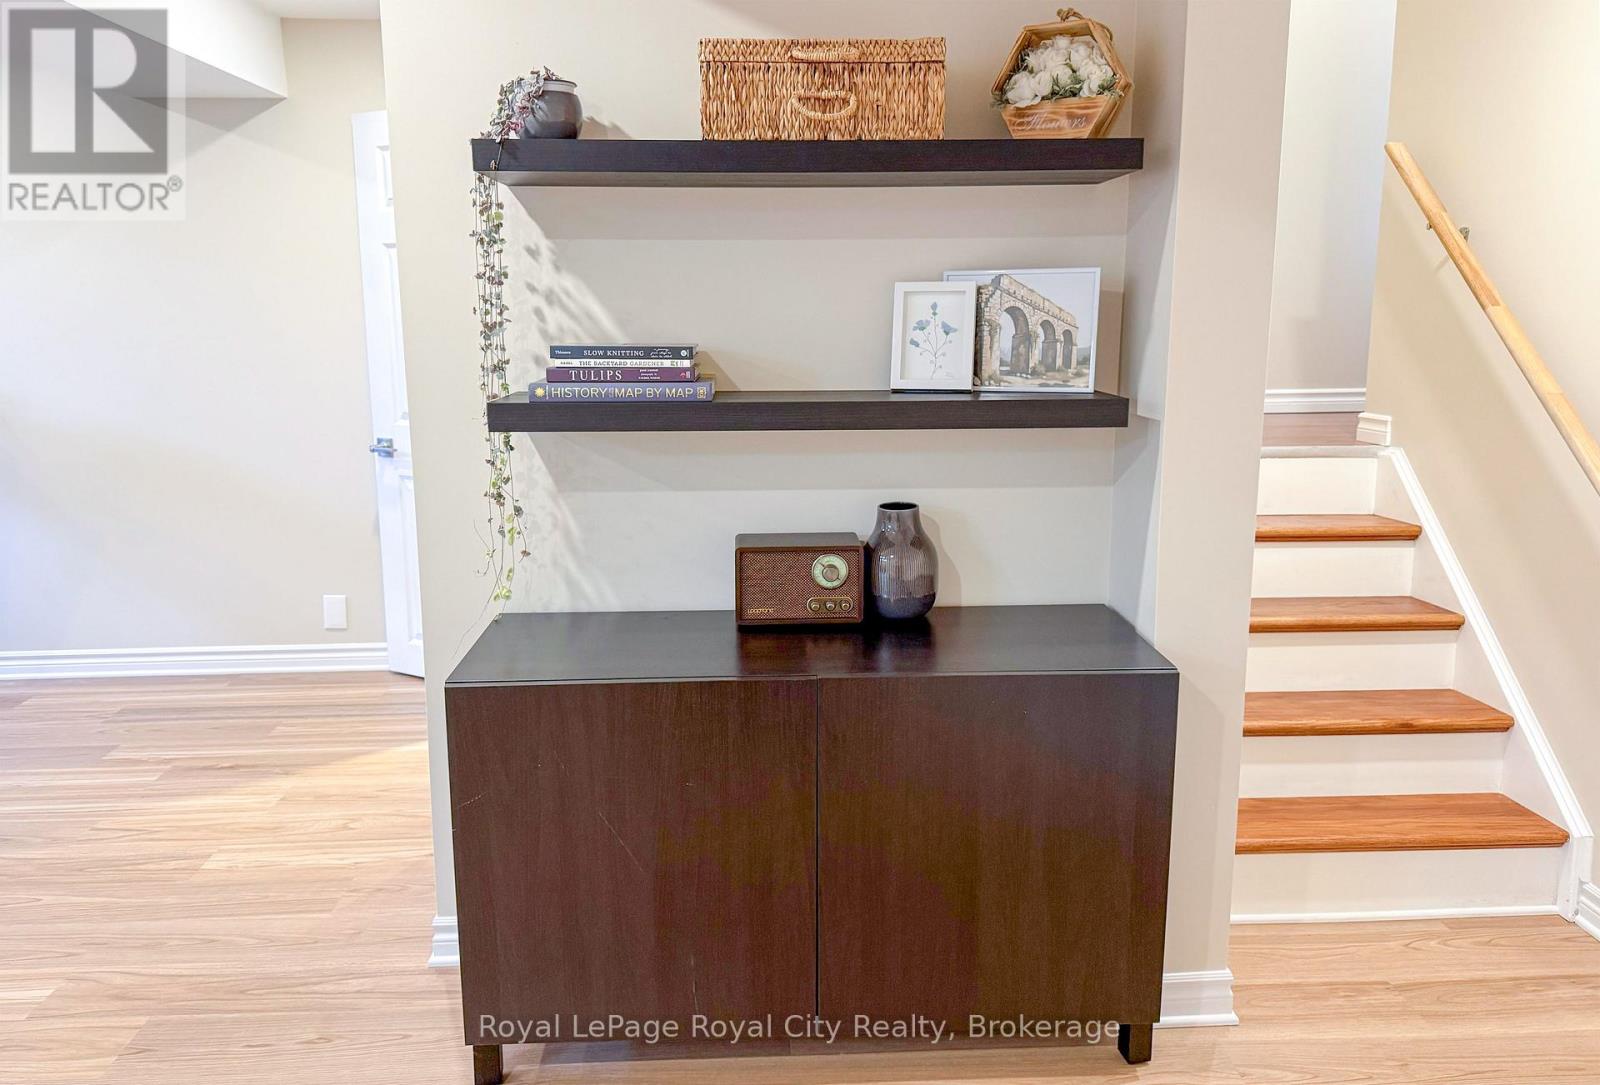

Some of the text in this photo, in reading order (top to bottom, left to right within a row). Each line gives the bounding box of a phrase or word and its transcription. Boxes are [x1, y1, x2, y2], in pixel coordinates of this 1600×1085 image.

[569, 370, 622, 381] TULIPS
[551, 387, 607, 398] HISTORY
[615, 387, 643, 398] MAP
[646, 387, 662, 398] BY
[665, 387, 694, 398] MAP
